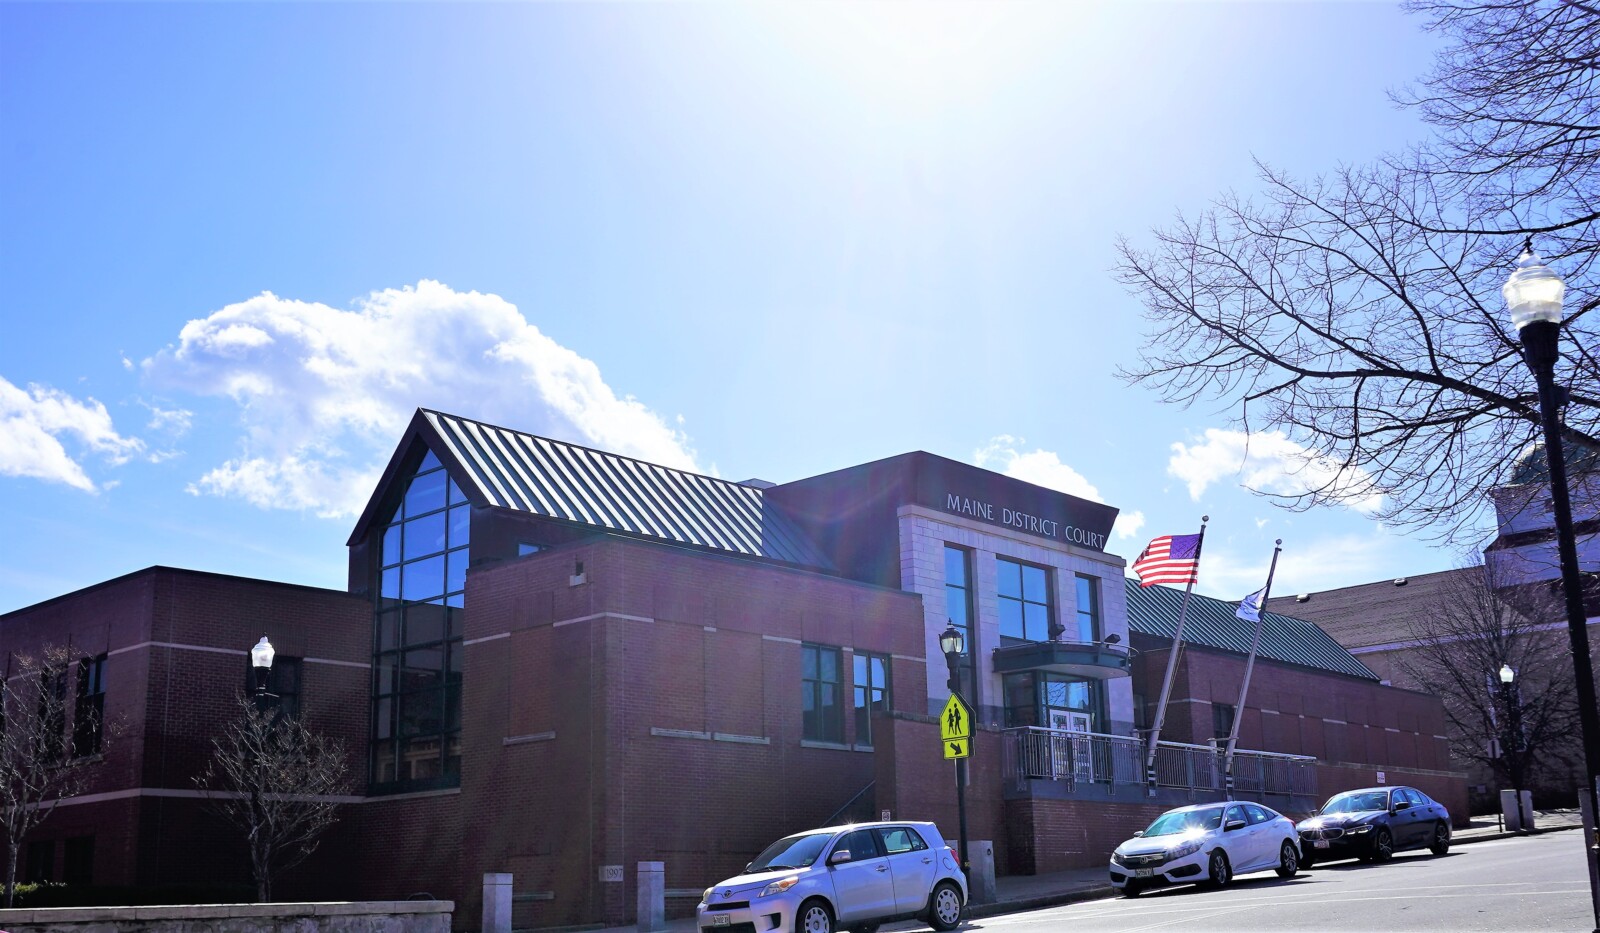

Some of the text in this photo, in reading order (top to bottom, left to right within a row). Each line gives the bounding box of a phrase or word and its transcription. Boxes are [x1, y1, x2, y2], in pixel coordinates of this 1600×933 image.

[947, 493, 1105, 549] MAINE DISTRICT COURT
[606, 867, 624, 879] 1997
